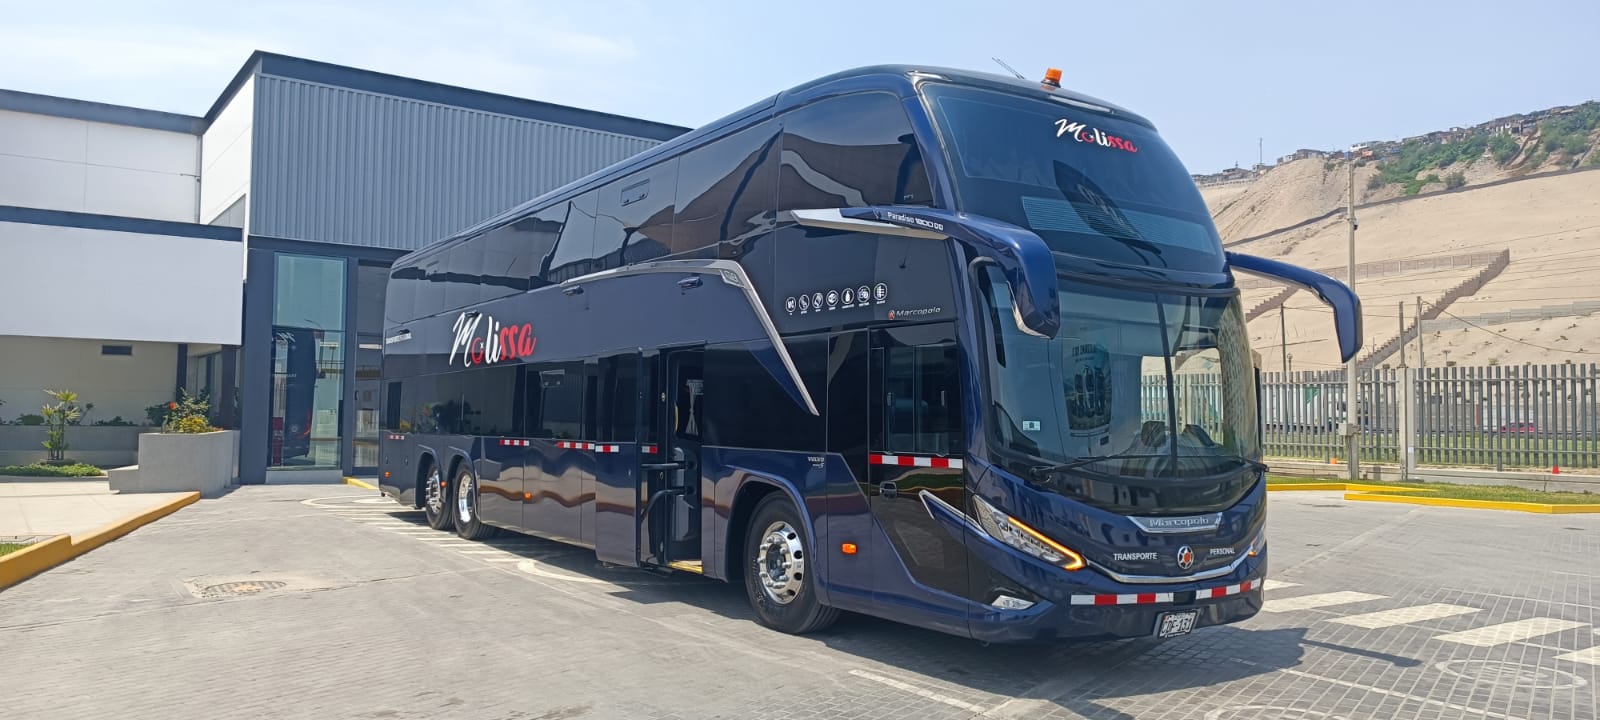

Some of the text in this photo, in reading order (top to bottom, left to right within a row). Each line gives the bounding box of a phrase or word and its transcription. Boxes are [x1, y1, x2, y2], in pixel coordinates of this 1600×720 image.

[887, 211, 915, 223] Paradiso
[896, 306, 941, 317] Marcopolo
[1149, 516, 1209, 527] Marcopolo
[1113, 547, 1235, 561] TRANSPORTE PERSONAL
